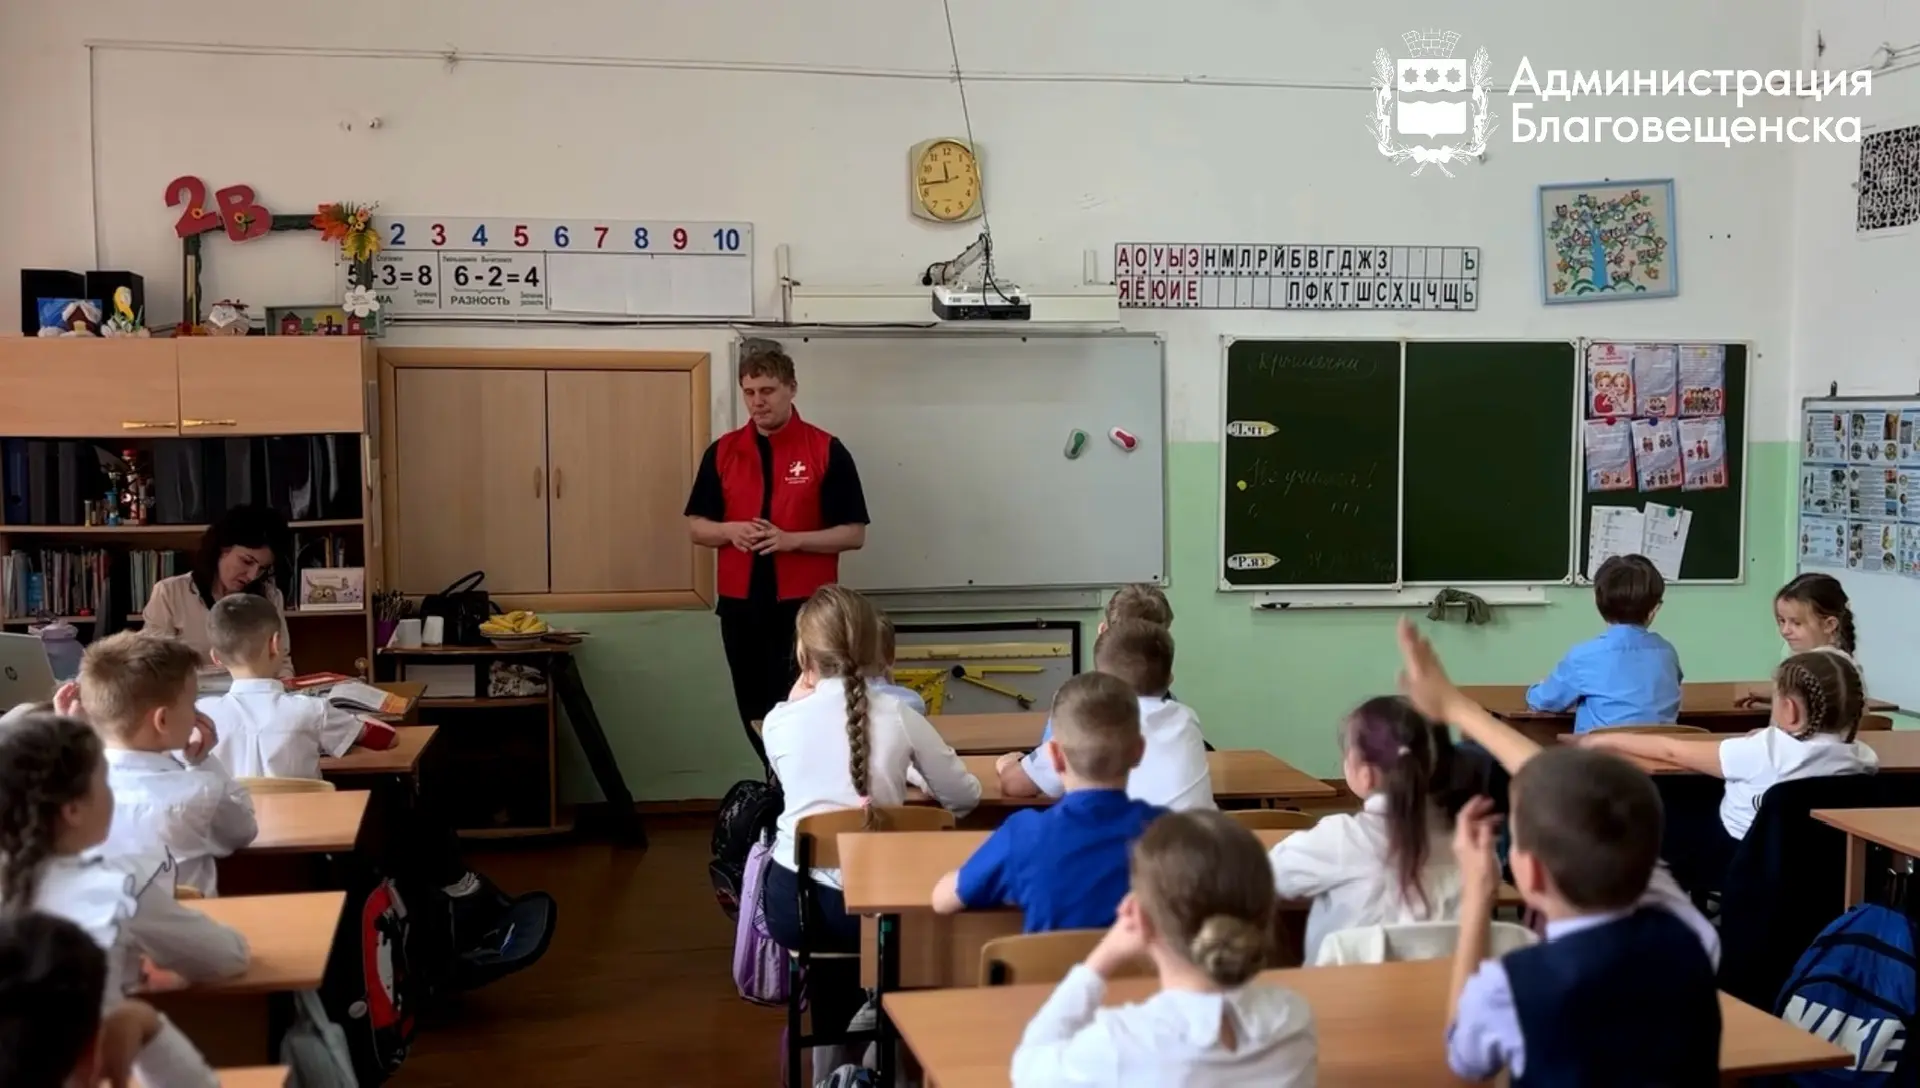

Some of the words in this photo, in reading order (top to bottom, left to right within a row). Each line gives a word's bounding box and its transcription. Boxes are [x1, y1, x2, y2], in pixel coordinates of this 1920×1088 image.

[390, 223, 406, 246] 2
[431, 224, 447, 247] 3
[471, 224, 489, 247] 4
[514, 225, 529, 247] 5
[554, 226, 570, 248] 6
[594, 227, 609, 249] 7
[634, 227, 649, 249] 8
[673, 228, 688, 250] 9
[713, 228, 740, 250] 10
[450, 295, 511, 306] РАЗНОСТЬ
